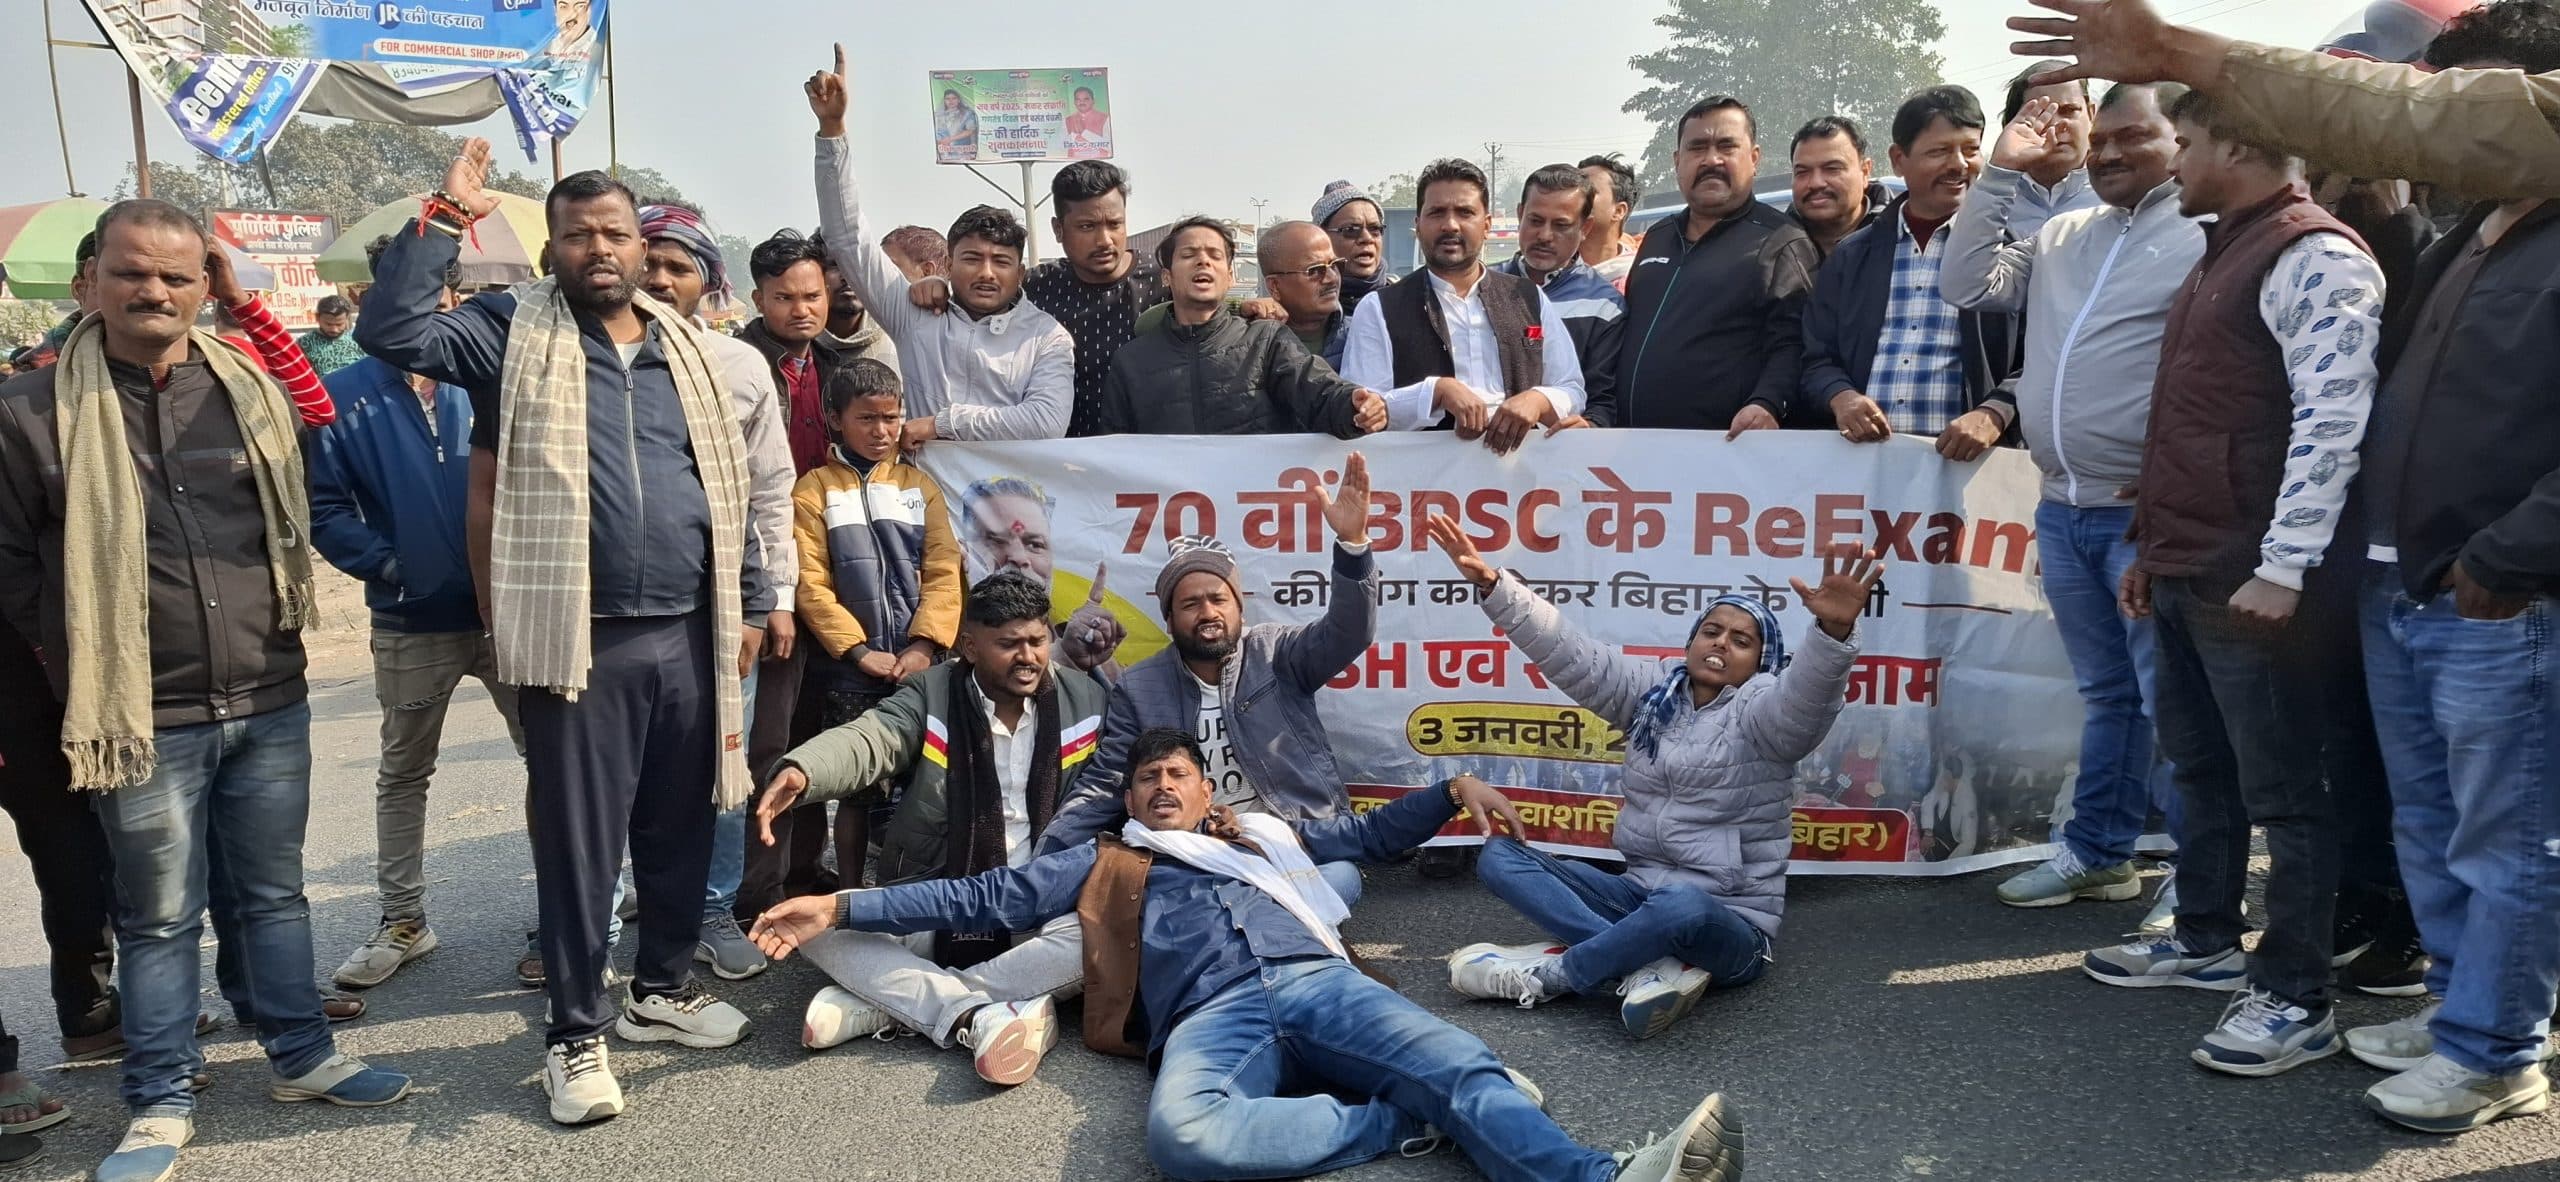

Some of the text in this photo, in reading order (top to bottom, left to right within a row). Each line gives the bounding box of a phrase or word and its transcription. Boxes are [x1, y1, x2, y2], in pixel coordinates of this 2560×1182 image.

[378, 3, 400, 26] JR
[403, 6, 427, 24] की
[431, 10, 484, 29] पहचान
[380, 41, 400, 53] FOR
[403, 43, 466, 57] COMMERCIAL
[470, 48, 495, 59] SHOP
[993, 125, 1041, 139] की हार्दिक
[282, 214, 322, 241] पुलिस
[1115, 491, 1217, 554] 70
[1237, 467, 1340, 554] वीं
[1581, 466, 1672, 553] के
[1271, 569, 1331, 607] की
[1422, 625, 1511, 688] एवं
[1419, 717, 1444, 746] 3
[1452, 710, 1593, 755] जनवरी,
